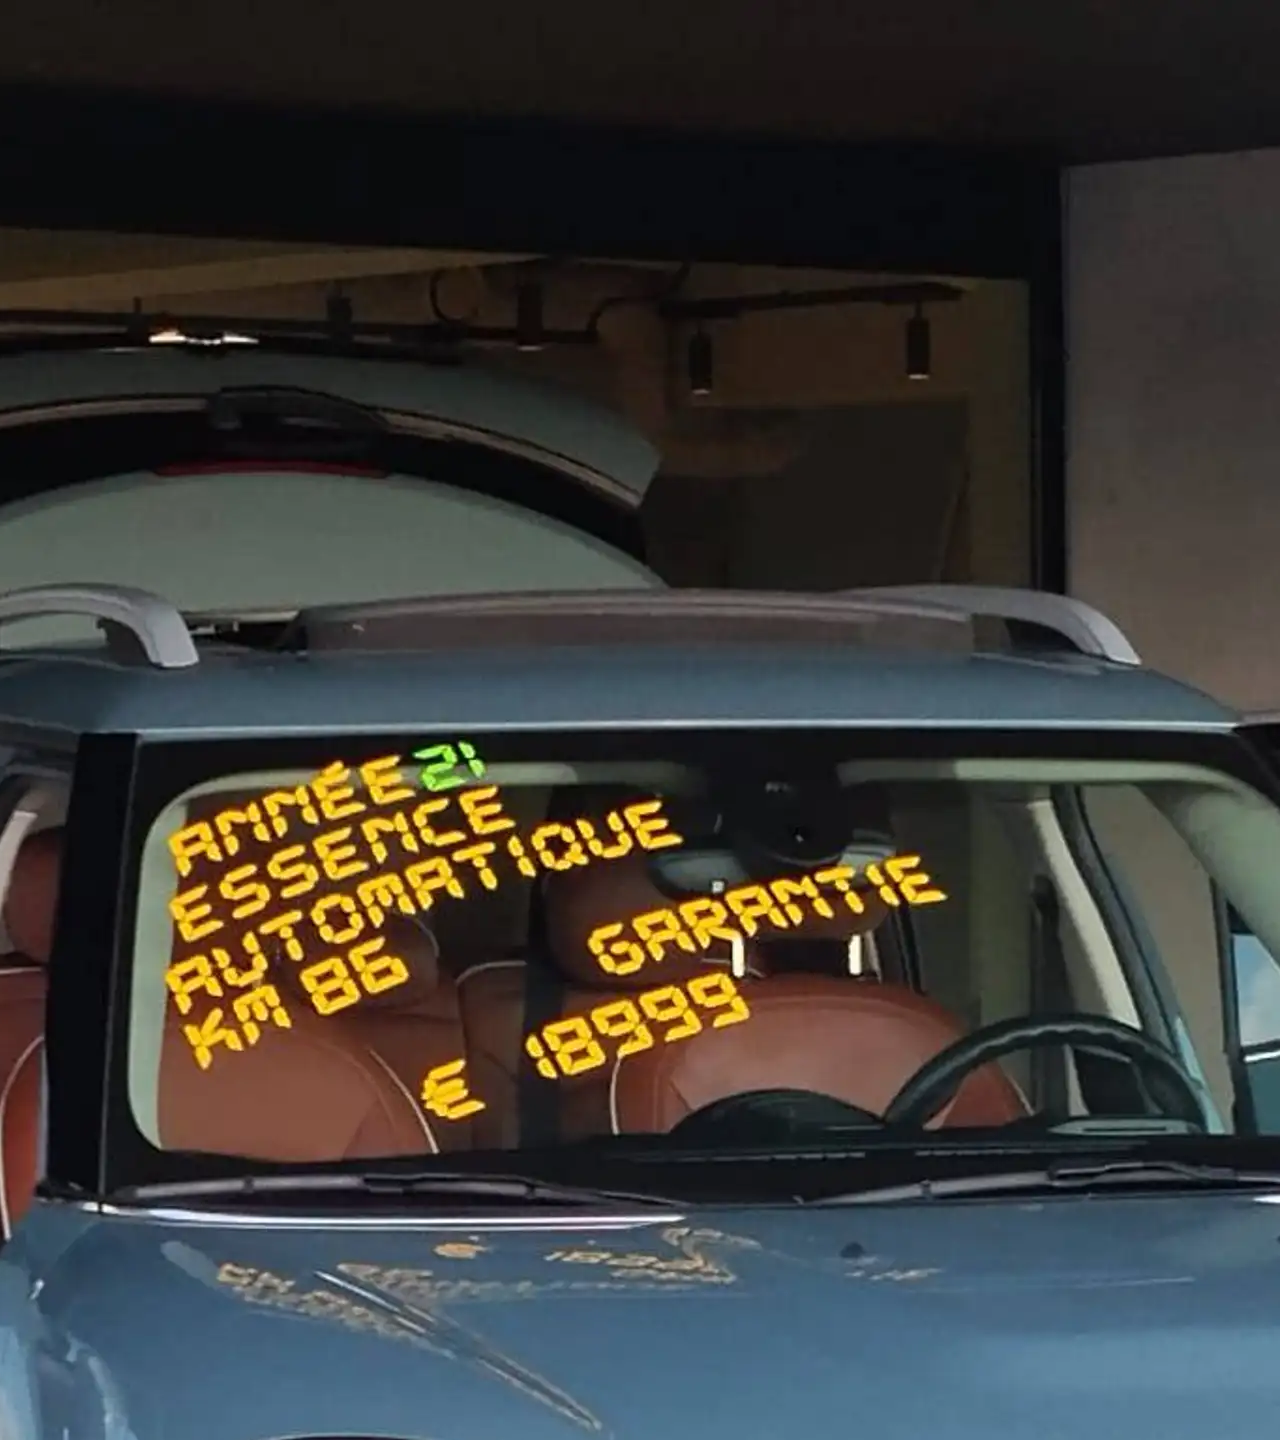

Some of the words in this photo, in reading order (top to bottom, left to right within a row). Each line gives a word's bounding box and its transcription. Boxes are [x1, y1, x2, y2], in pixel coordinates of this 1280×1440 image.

[167, 755, 418, 878] ANNÉE
[412, 741, 488, 793] 21
[168, 785, 517, 943] ESSENCE
[164, 800, 683, 1016] AUTOMATIQUE
[587, 855, 947, 976] GARANTIE
[183, 1006, 293, 1071] KM
[299, 936, 410, 1016] 86
[420, 1058, 487, 1121] €
[524, 972, 751, 1079] 18999
